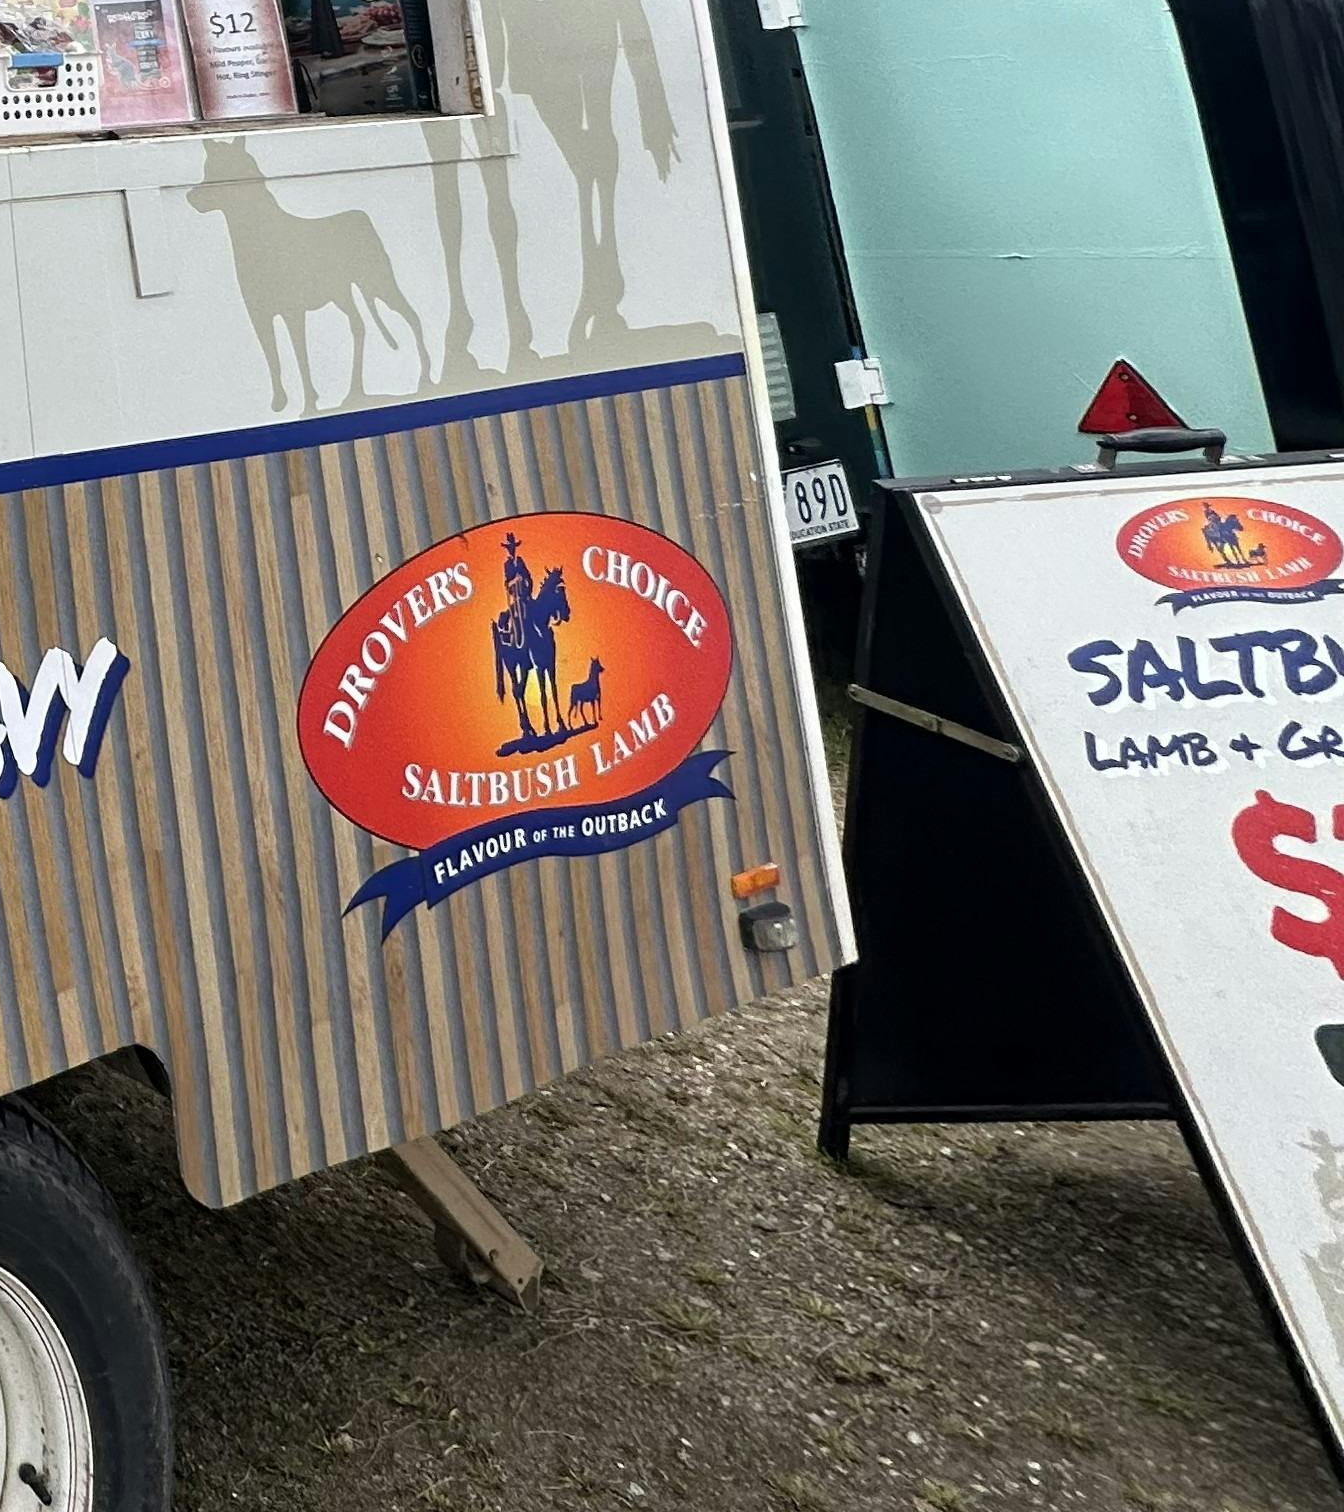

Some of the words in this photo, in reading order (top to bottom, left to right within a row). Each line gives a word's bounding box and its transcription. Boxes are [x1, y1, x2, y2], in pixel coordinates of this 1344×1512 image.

[209, 12, 257, 38] $12
[1246, 507, 1327, 547] CHOICE
[1266, 556, 1313, 582] LAMB
[1191, 589, 1239, 603] FLAVOUR
[322, 561, 474, 749] DROVER'S
[581, 545, 708, 648] CHOICE
[401, 753, 581, 807] SALTBUSH
[592, 691, 678, 778] LAMB
[1083, 730, 1217, 771] LAMB
[433, 828, 527, 884] FLAVOUR
[532, 829, 548, 844] OF
[552, 824, 575, 839] THE
[581, 798, 667, 837] OUTBACK
